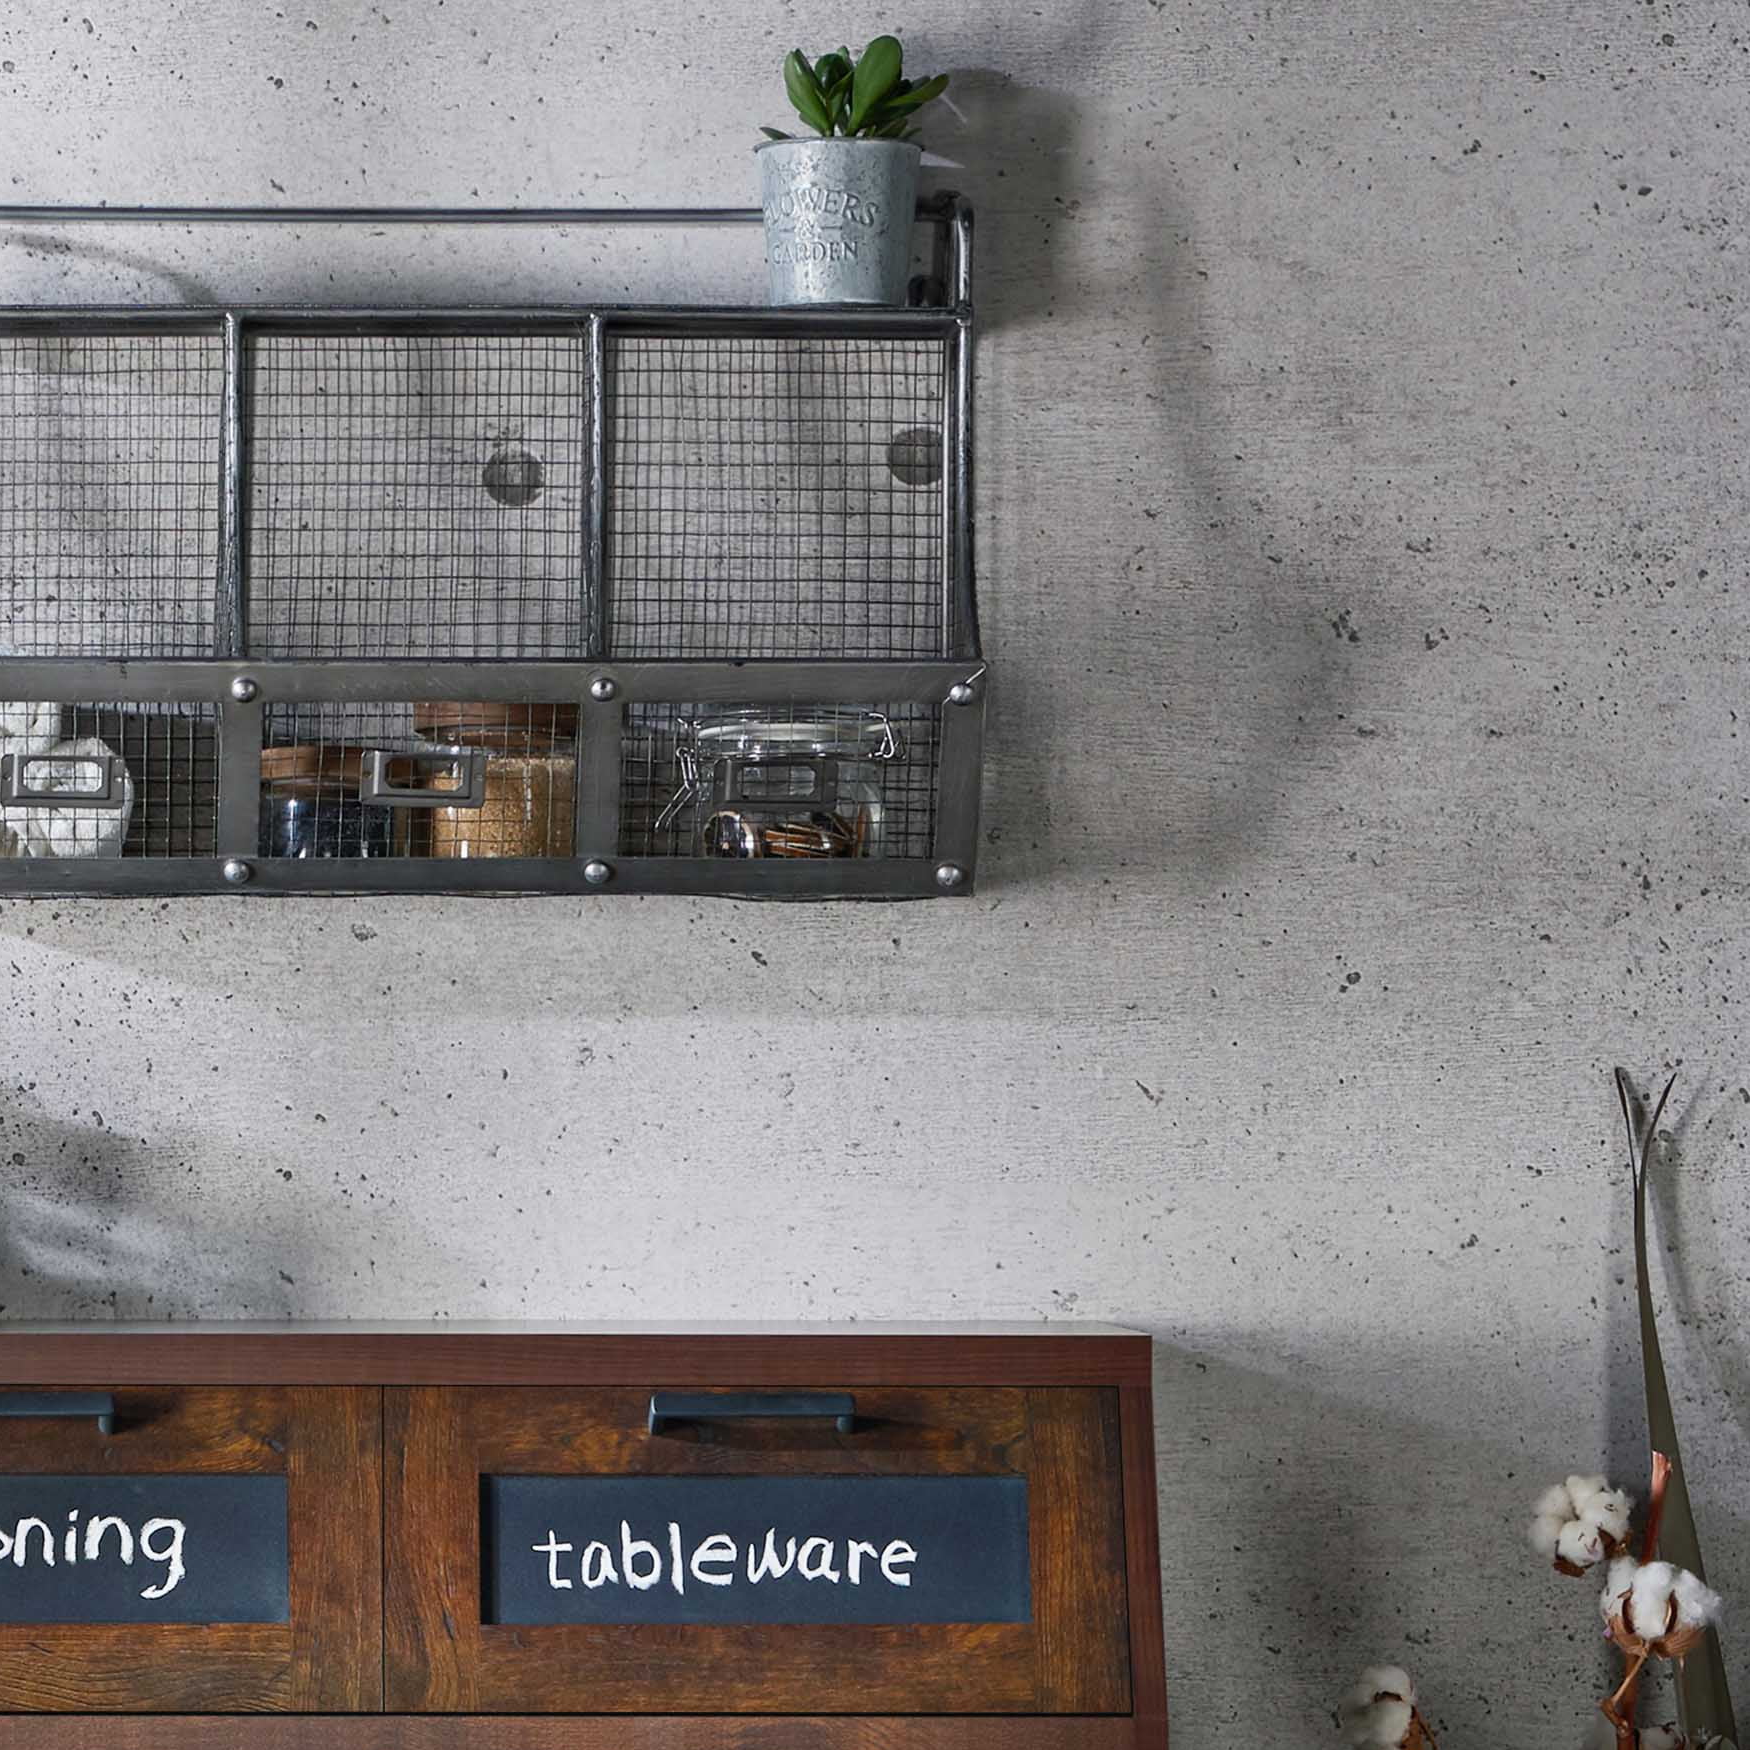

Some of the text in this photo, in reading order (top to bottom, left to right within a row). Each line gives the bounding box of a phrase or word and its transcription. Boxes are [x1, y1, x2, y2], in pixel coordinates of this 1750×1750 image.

[799, 219, 815, 239] &
[771, 241, 859, 264] GARDEN
[532, 1519, 918, 1595] tableware
